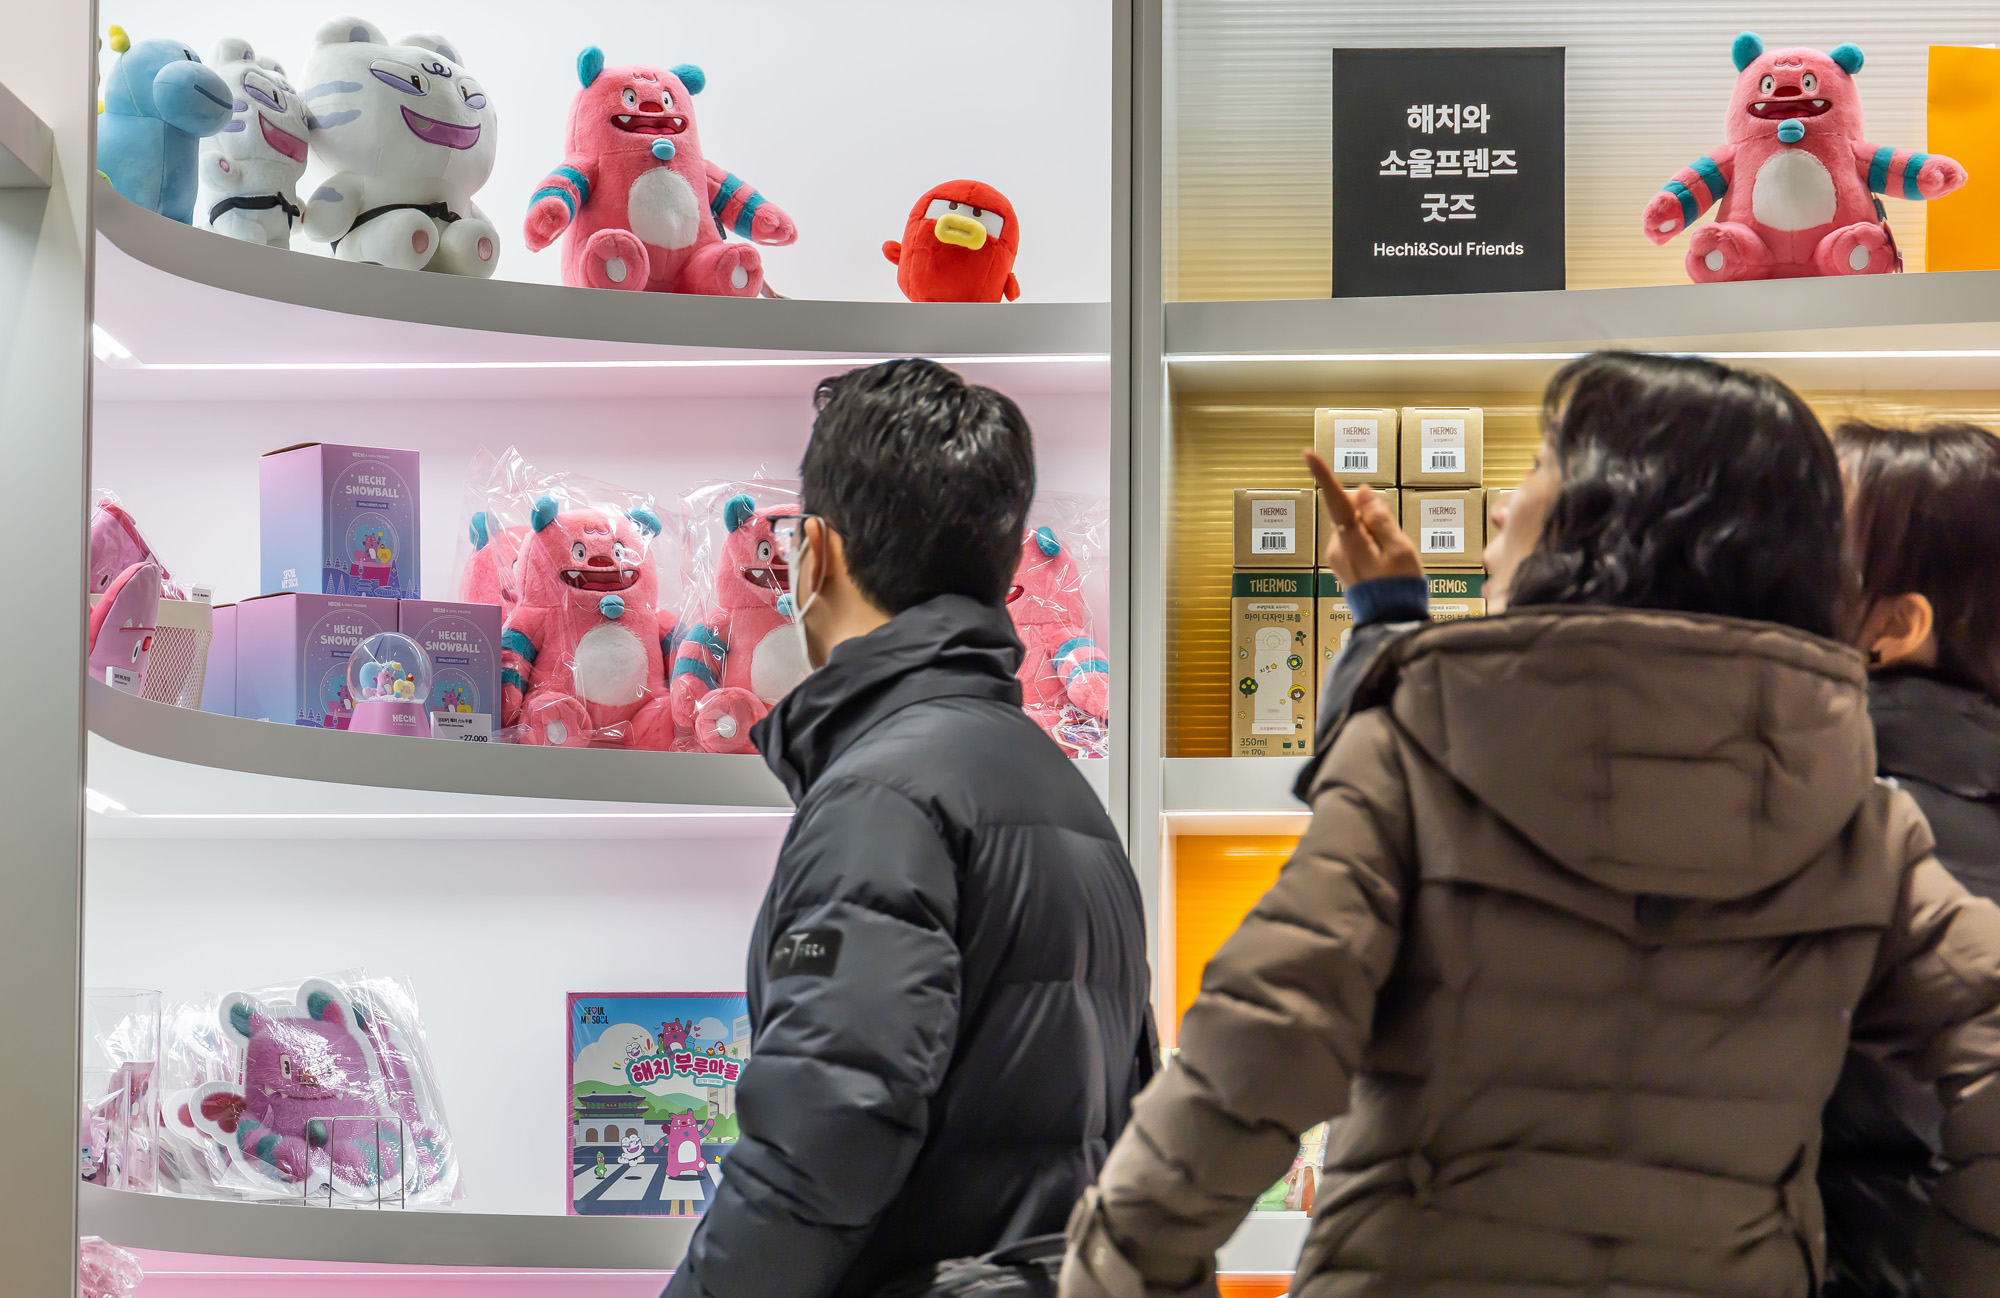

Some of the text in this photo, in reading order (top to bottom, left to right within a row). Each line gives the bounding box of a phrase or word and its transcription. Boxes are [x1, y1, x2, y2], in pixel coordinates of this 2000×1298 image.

[1406, 104, 1490, 134] 해치와
[1379, 148, 1518, 178] 소울프렌즈
[1421, 193, 1477, 223] 굿즈
[1373, 242, 1524, 257] Hechi&Soul Friends
[1342, 427, 1371, 435] THERMOS
[1429, 427, 1458, 435] THERMOS
[358, 475, 387, 486] HECHI
[345, 485, 399, 498] SNOWBALL
[1259, 507, 1288, 516] THERMOS
[1428, 507, 1457, 515] THERMOS
[1249, 578, 1298, 593] THERMOS
[1427, 578, 1468, 593] HERMOS
[1245, 613, 1301, 623] 마이 디자인 보틀
[1330, 613, 1346, 621] 마이
[333, 624, 363, 635] HECHI
[438, 630, 468, 641] HECHI
[425, 640, 480, 654] SNOWBALL
[392, 714, 416, 723] HECHI
[1240, 737, 1268, 746] 350ml
[1251, 748, 1266, 756] 170g
[591, 1016, 609, 1024] SOUL
[631, 1053, 739, 1082] 해치 부루마불
